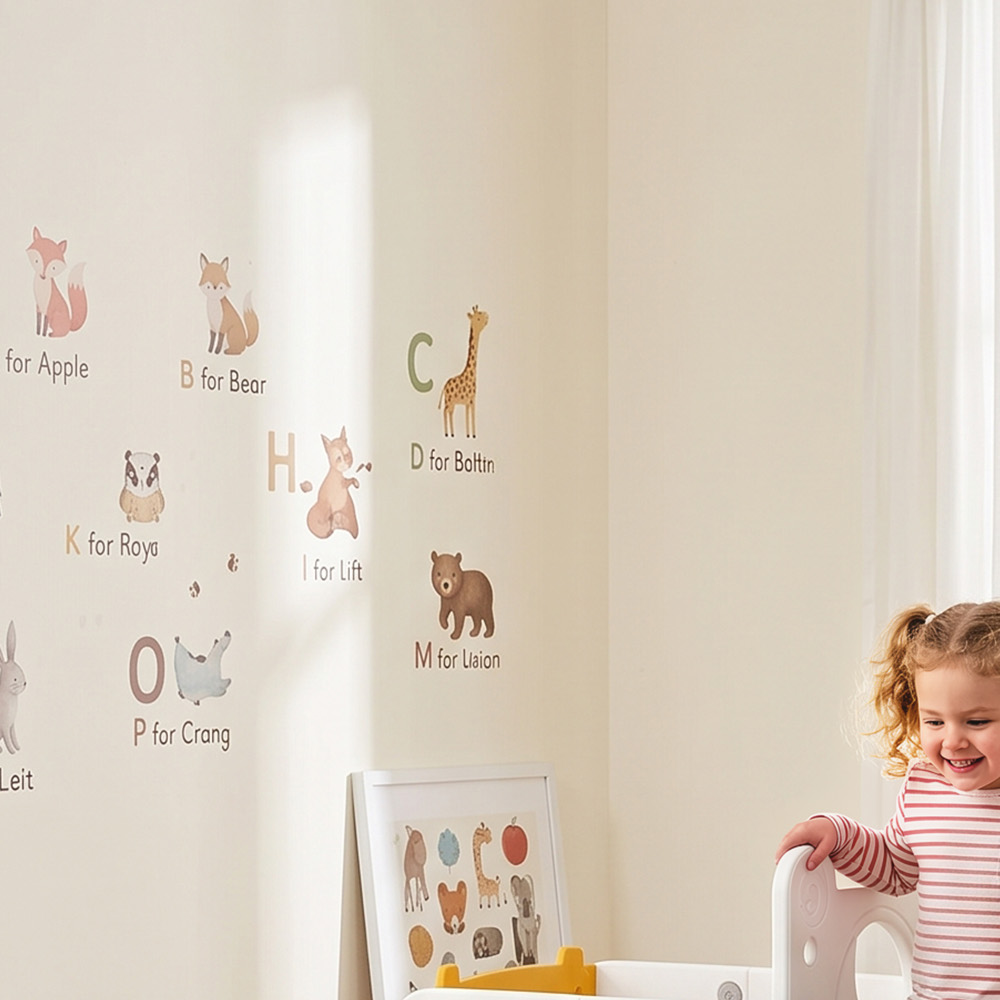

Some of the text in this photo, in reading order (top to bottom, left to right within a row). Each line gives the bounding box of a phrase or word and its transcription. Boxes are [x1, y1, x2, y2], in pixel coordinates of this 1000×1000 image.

[5, 347, 89, 385] for Apple
[180, 359, 267, 394] B for Bear
[408, 332, 433, 393] C
[268, 430, 295, 493] H
[411, 442, 424, 470] D
[429, 448, 450, 471] for
[66, 524, 81, 556] K
[88, 531, 114, 556] for
[313, 558, 335, 581] for
[129, 635, 165, 704] O
[415, 641, 432, 669] M
[438, 647, 458, 669] for
[134, 717, 230, 752] P for Crang
